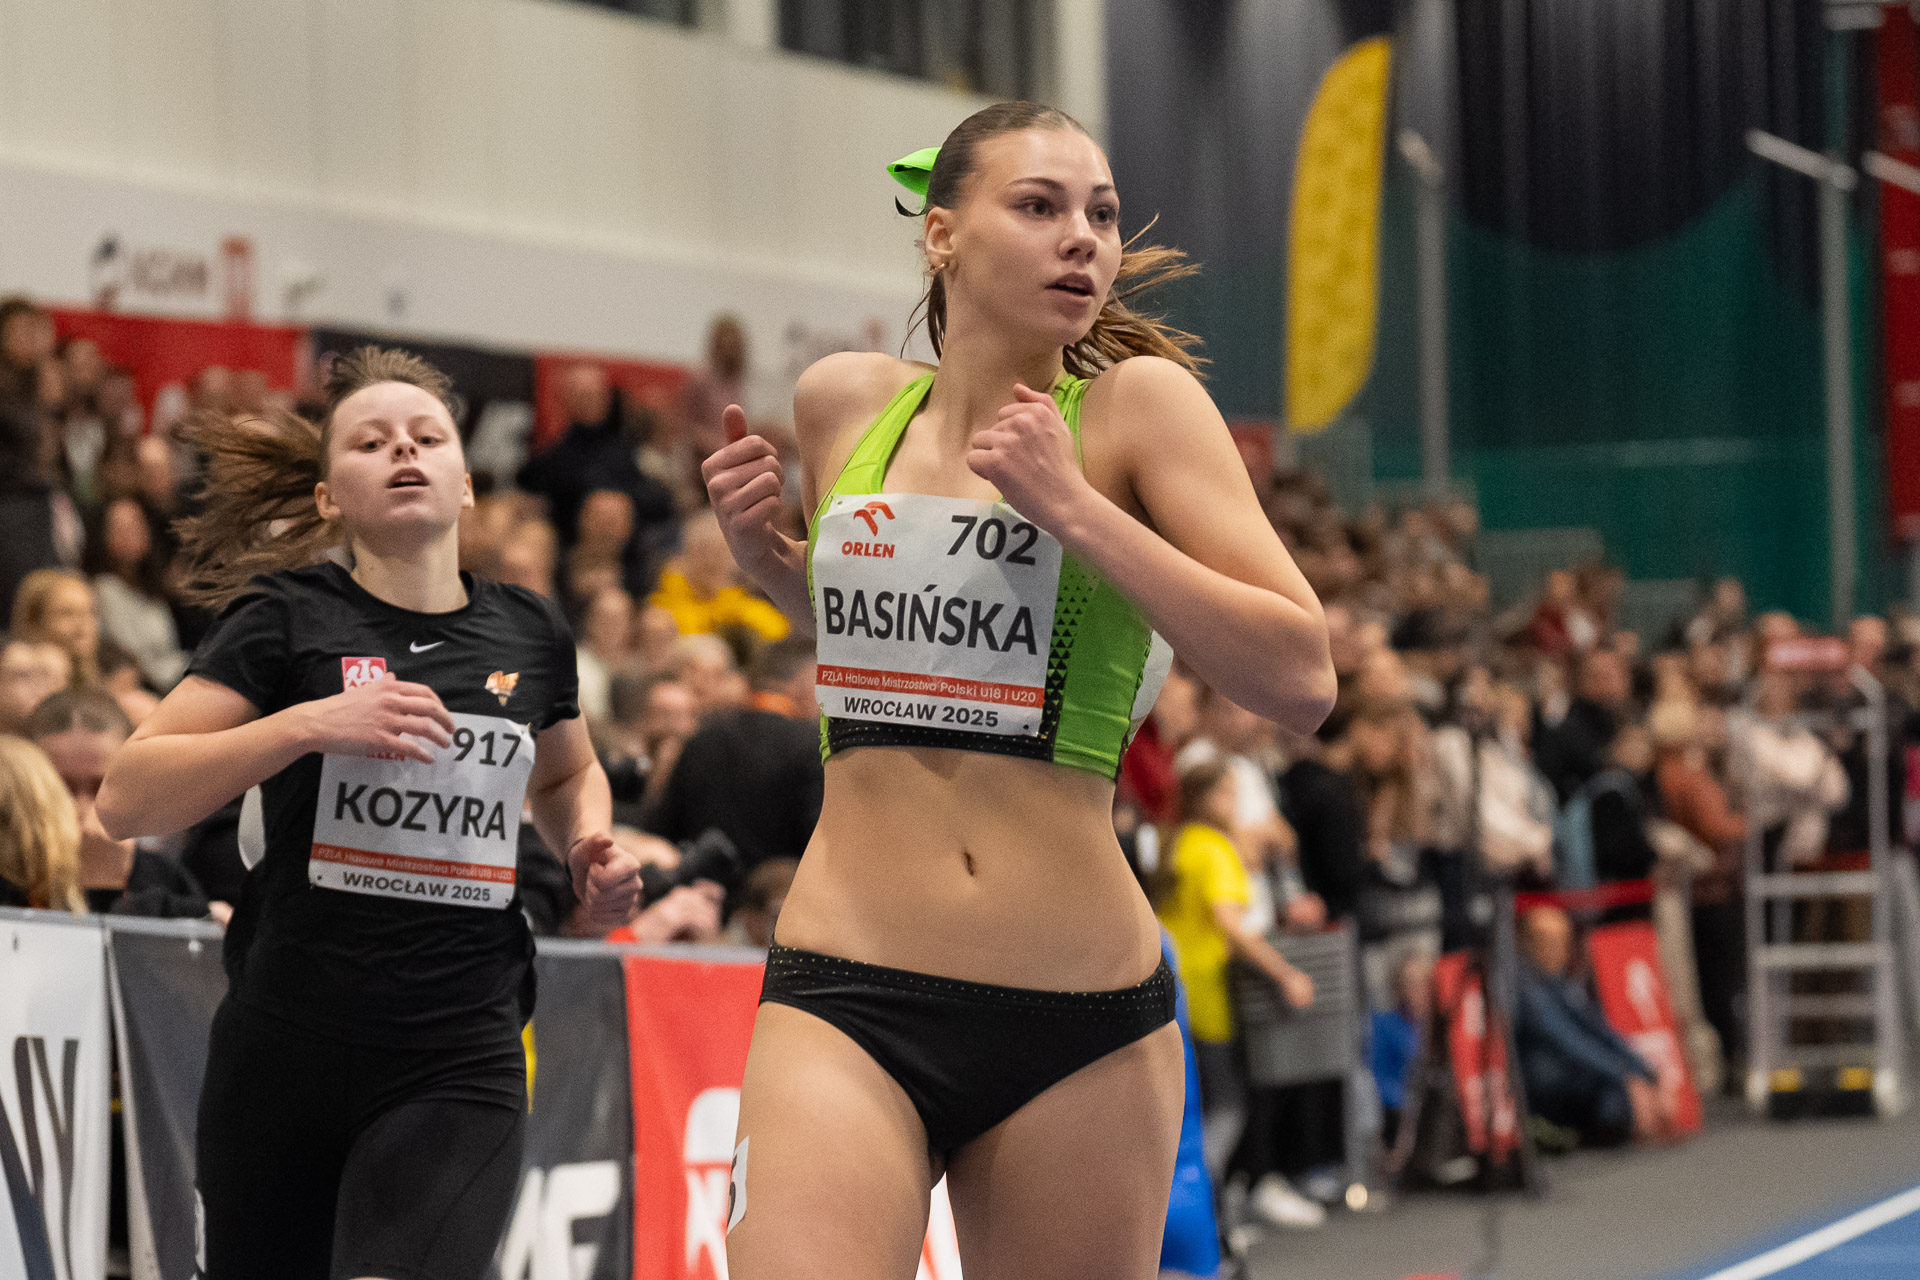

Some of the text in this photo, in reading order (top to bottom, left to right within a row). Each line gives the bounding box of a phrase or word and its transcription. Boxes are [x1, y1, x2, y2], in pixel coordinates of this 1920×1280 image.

[841, 541, 895, 558] ORLEN
[947, 515, 1039, 566] 702
[823, 584, 1038, 655] BASIŃSKA
[821, 670, 1037, 703] PZLA Halowe Mistrzostwa Polski U18 i U20
[844, 696, 999, 727] WROCŁAW 2025
[452, 727, 522, 768] 917
[334, 781, 507, 841] KOZYRA
[343, 871, 491, 902] WROCŁAW 2025
